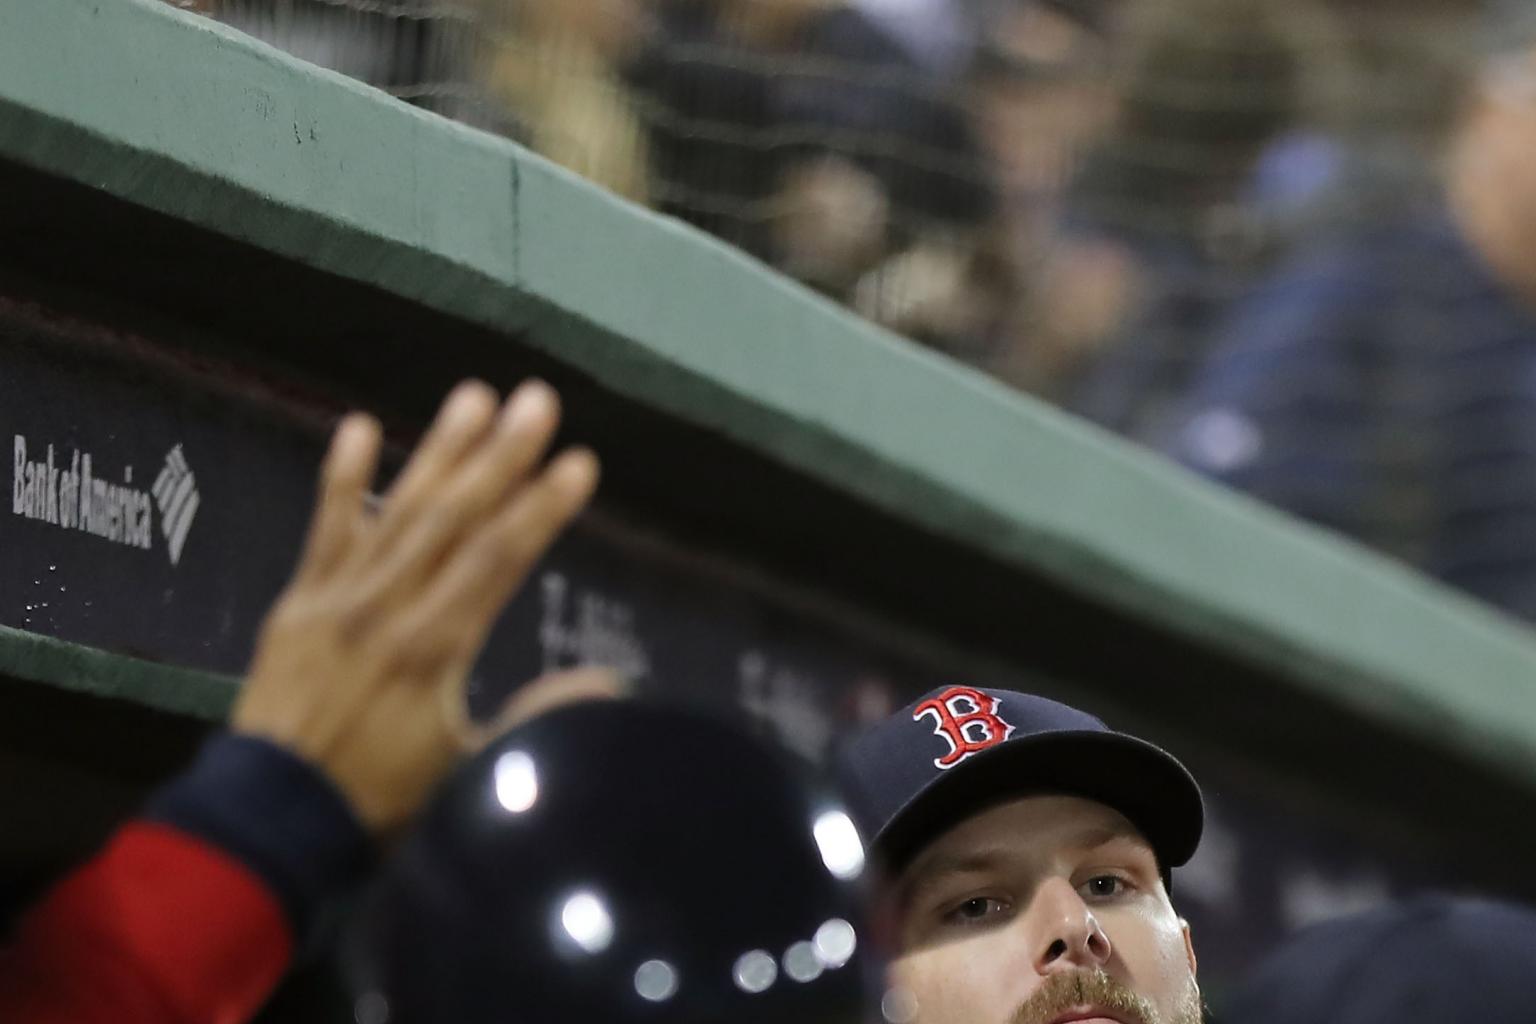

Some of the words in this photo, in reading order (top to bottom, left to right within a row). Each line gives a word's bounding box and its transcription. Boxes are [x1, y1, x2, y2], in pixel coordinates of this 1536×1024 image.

[13, 434, 58, 524] Bank
[59, 449, 80, 528] of
[79, 453, 151, 549] America
[912, 685, 1016, 769] B
